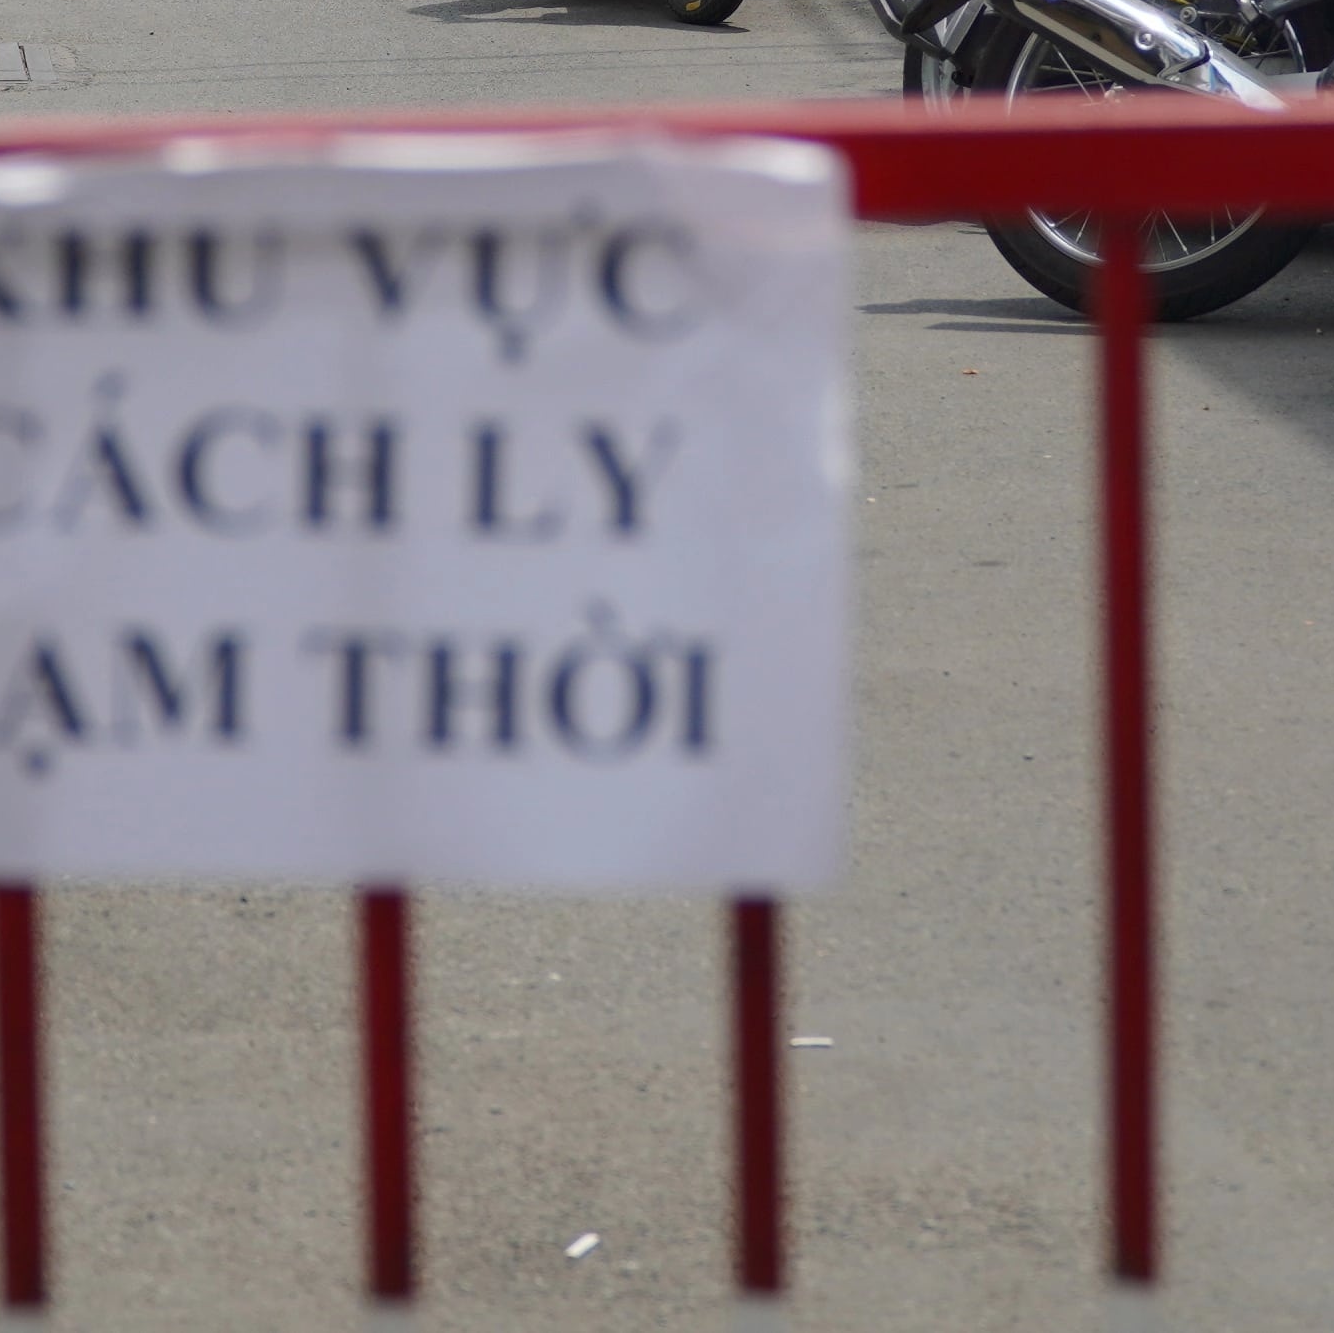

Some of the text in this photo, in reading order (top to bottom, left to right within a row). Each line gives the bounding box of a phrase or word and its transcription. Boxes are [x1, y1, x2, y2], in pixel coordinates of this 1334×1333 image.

[350, 197, 705, 367] VỰC
[468, 415, 681, 540] LY
[300, 597, 721, 763] THỜI
